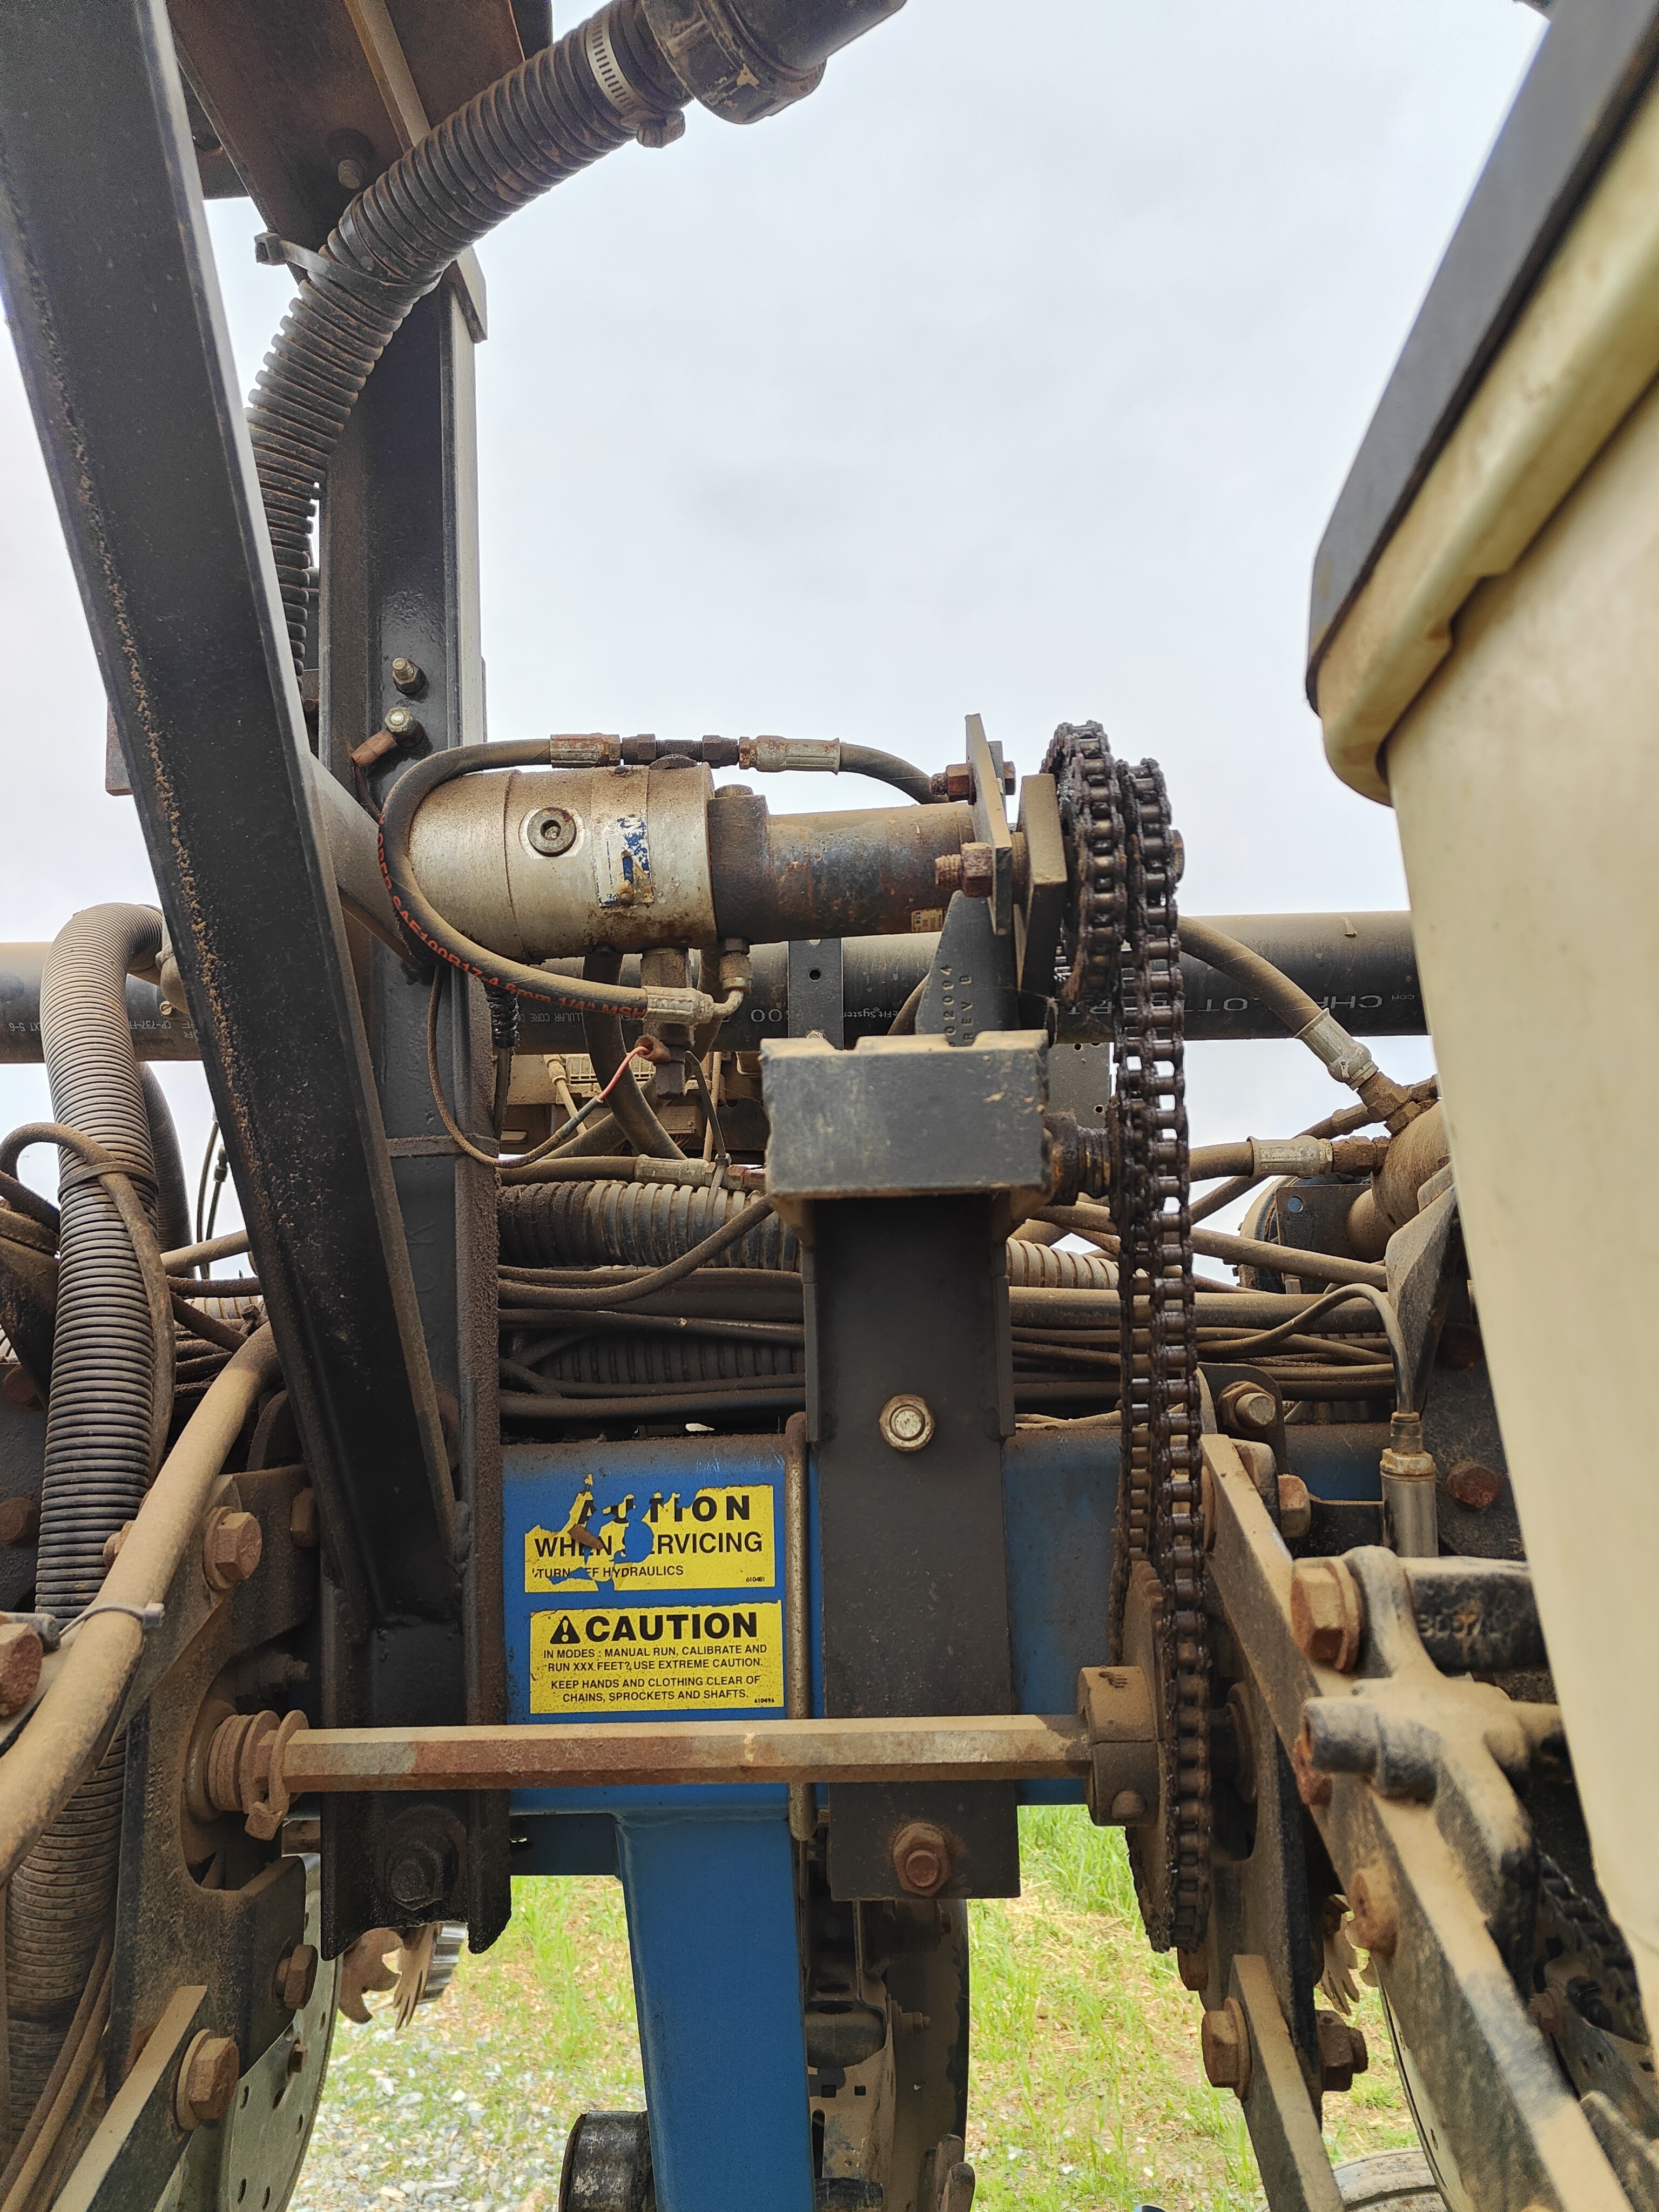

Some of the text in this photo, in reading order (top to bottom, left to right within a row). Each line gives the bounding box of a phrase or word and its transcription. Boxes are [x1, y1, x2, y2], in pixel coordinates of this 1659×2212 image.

[530, 1013, 550, 1023] CORE
[961, 1001, 973, 1042] REV
[603, 1565, 684, 1577] HYDRAULICS
[585, 1611, 757, 1642] CAUTION
[543, 1650, 554, 1658] IN
[557, 1649, 595, 1658] MODES
[604, 1648, 650, 1657] MANUAL
[653, 1647, 679, 1657] RUN,
[682, 1645, 742, 1655] CALIBRATE
[745, 1644, 767, 1654] AND
[548, 1662, 570, 1672] RUN
[573, 1662, 594, 1671] XXX
[633, 1660, 656, 1670] USE
[658, 1659, 710, 1669] EXTREME
[712, 1657, 763, 1668] CAUTION.
[551, 1675, 761, 1689] KEEP HANDS AND CLOTHING CLEAR OF
[563, 1689, 749, 1703] CHAINS, SPROCKETS AND SHAFTS.
